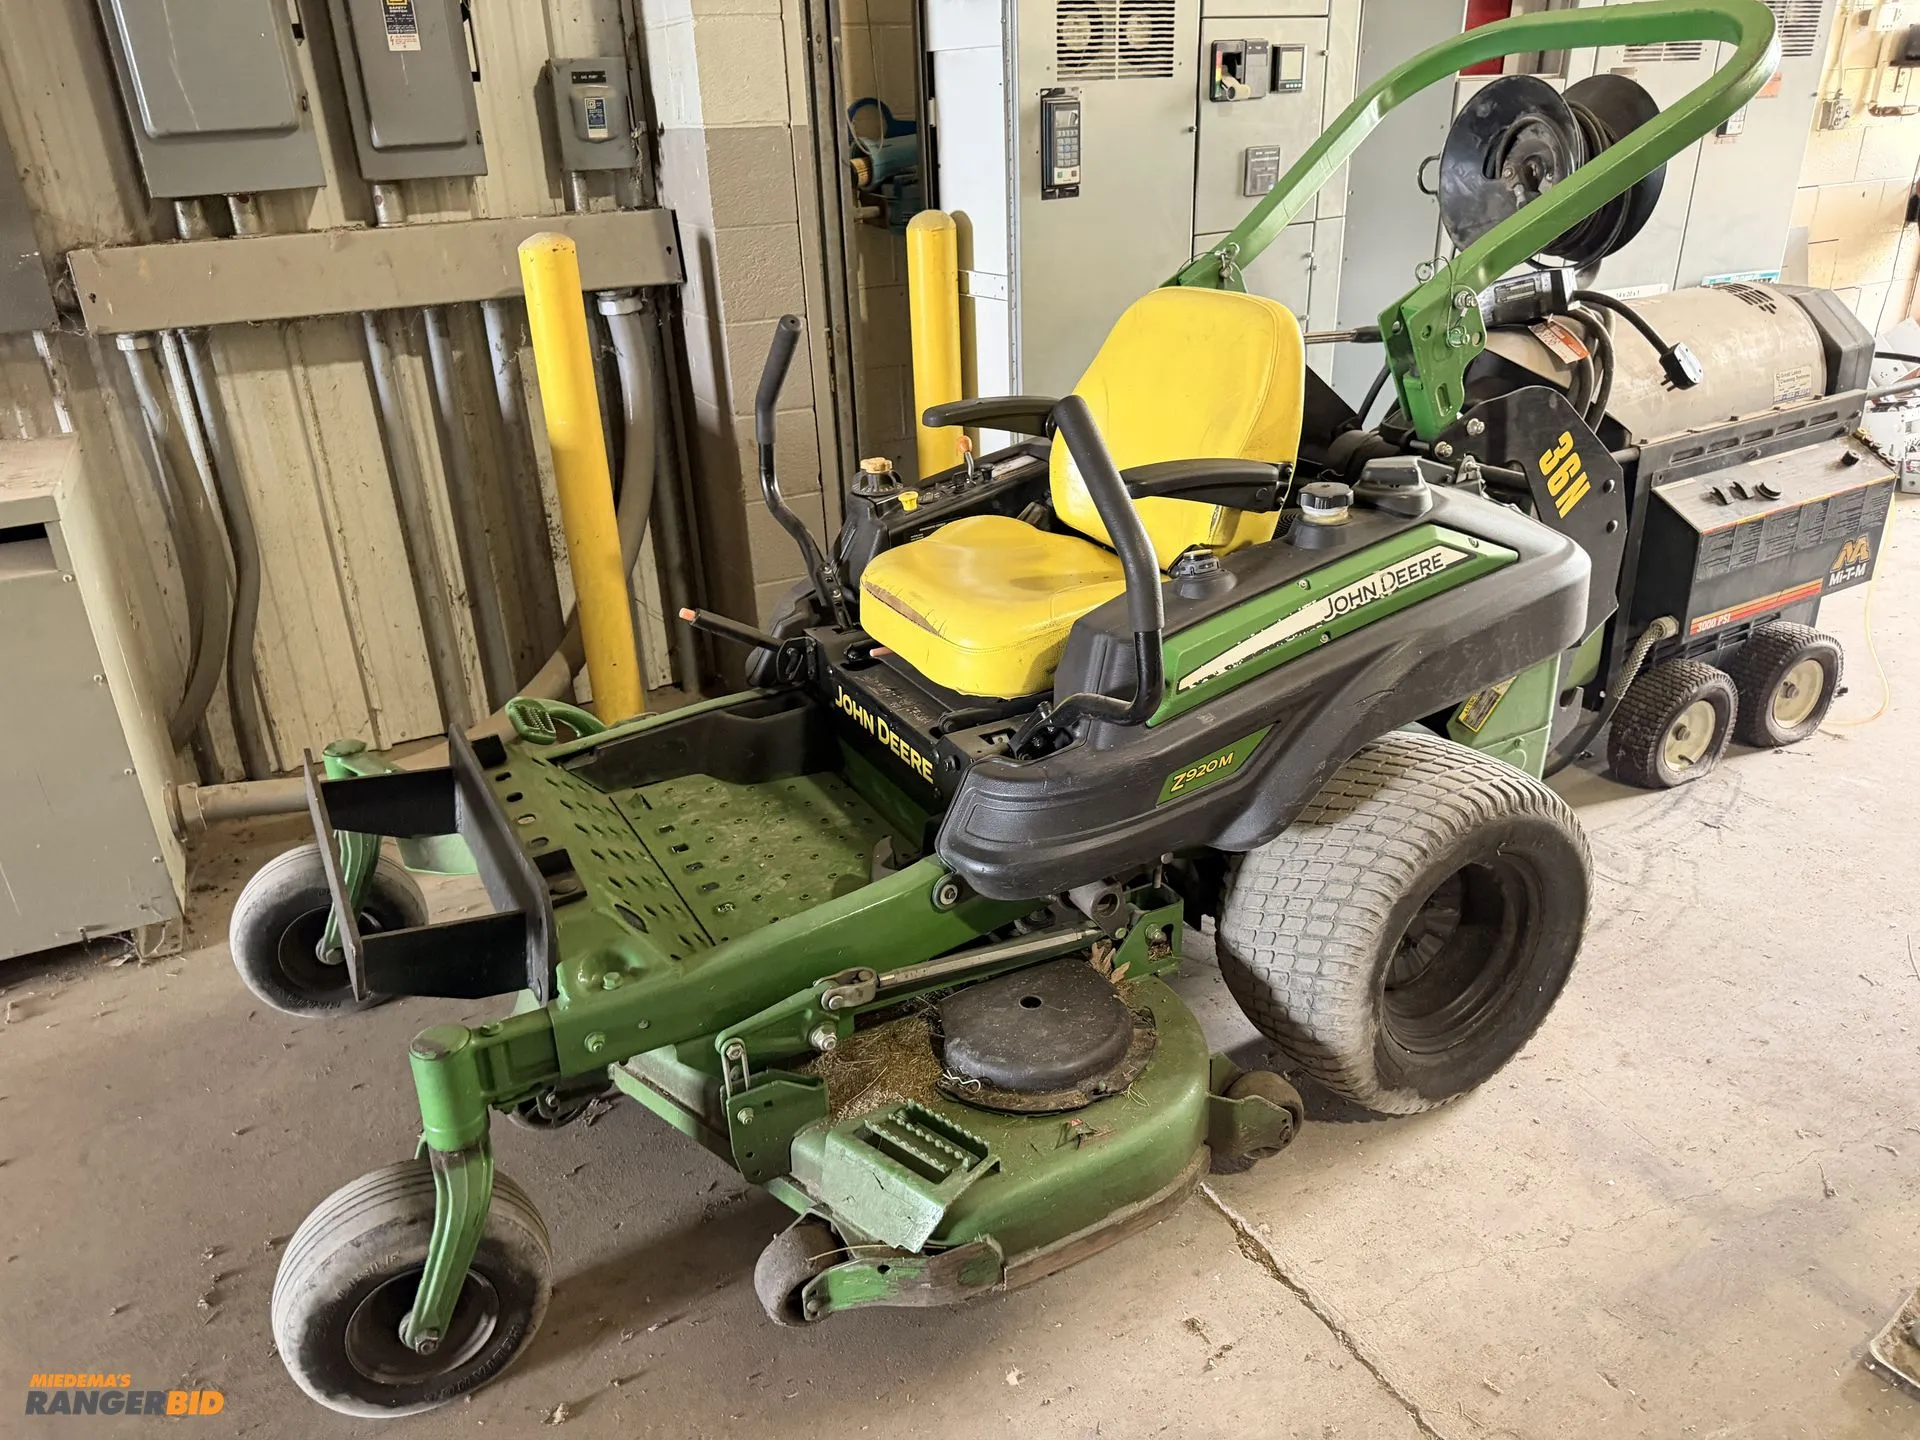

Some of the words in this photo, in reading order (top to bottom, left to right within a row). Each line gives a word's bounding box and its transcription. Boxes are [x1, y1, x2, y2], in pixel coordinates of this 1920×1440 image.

[1538, 430, 1591, 519] 36N
[1324, 582, 1377, 619] JOHN
[1380, 553, 1444, 593] DEERE
[1829, 562, 1868, 587] Mi-T-M
[835, 685, 875, 735] JOHN
[877, 716, 934, 785] DEERE
[1170, 752, 1234, 792] Z920M
